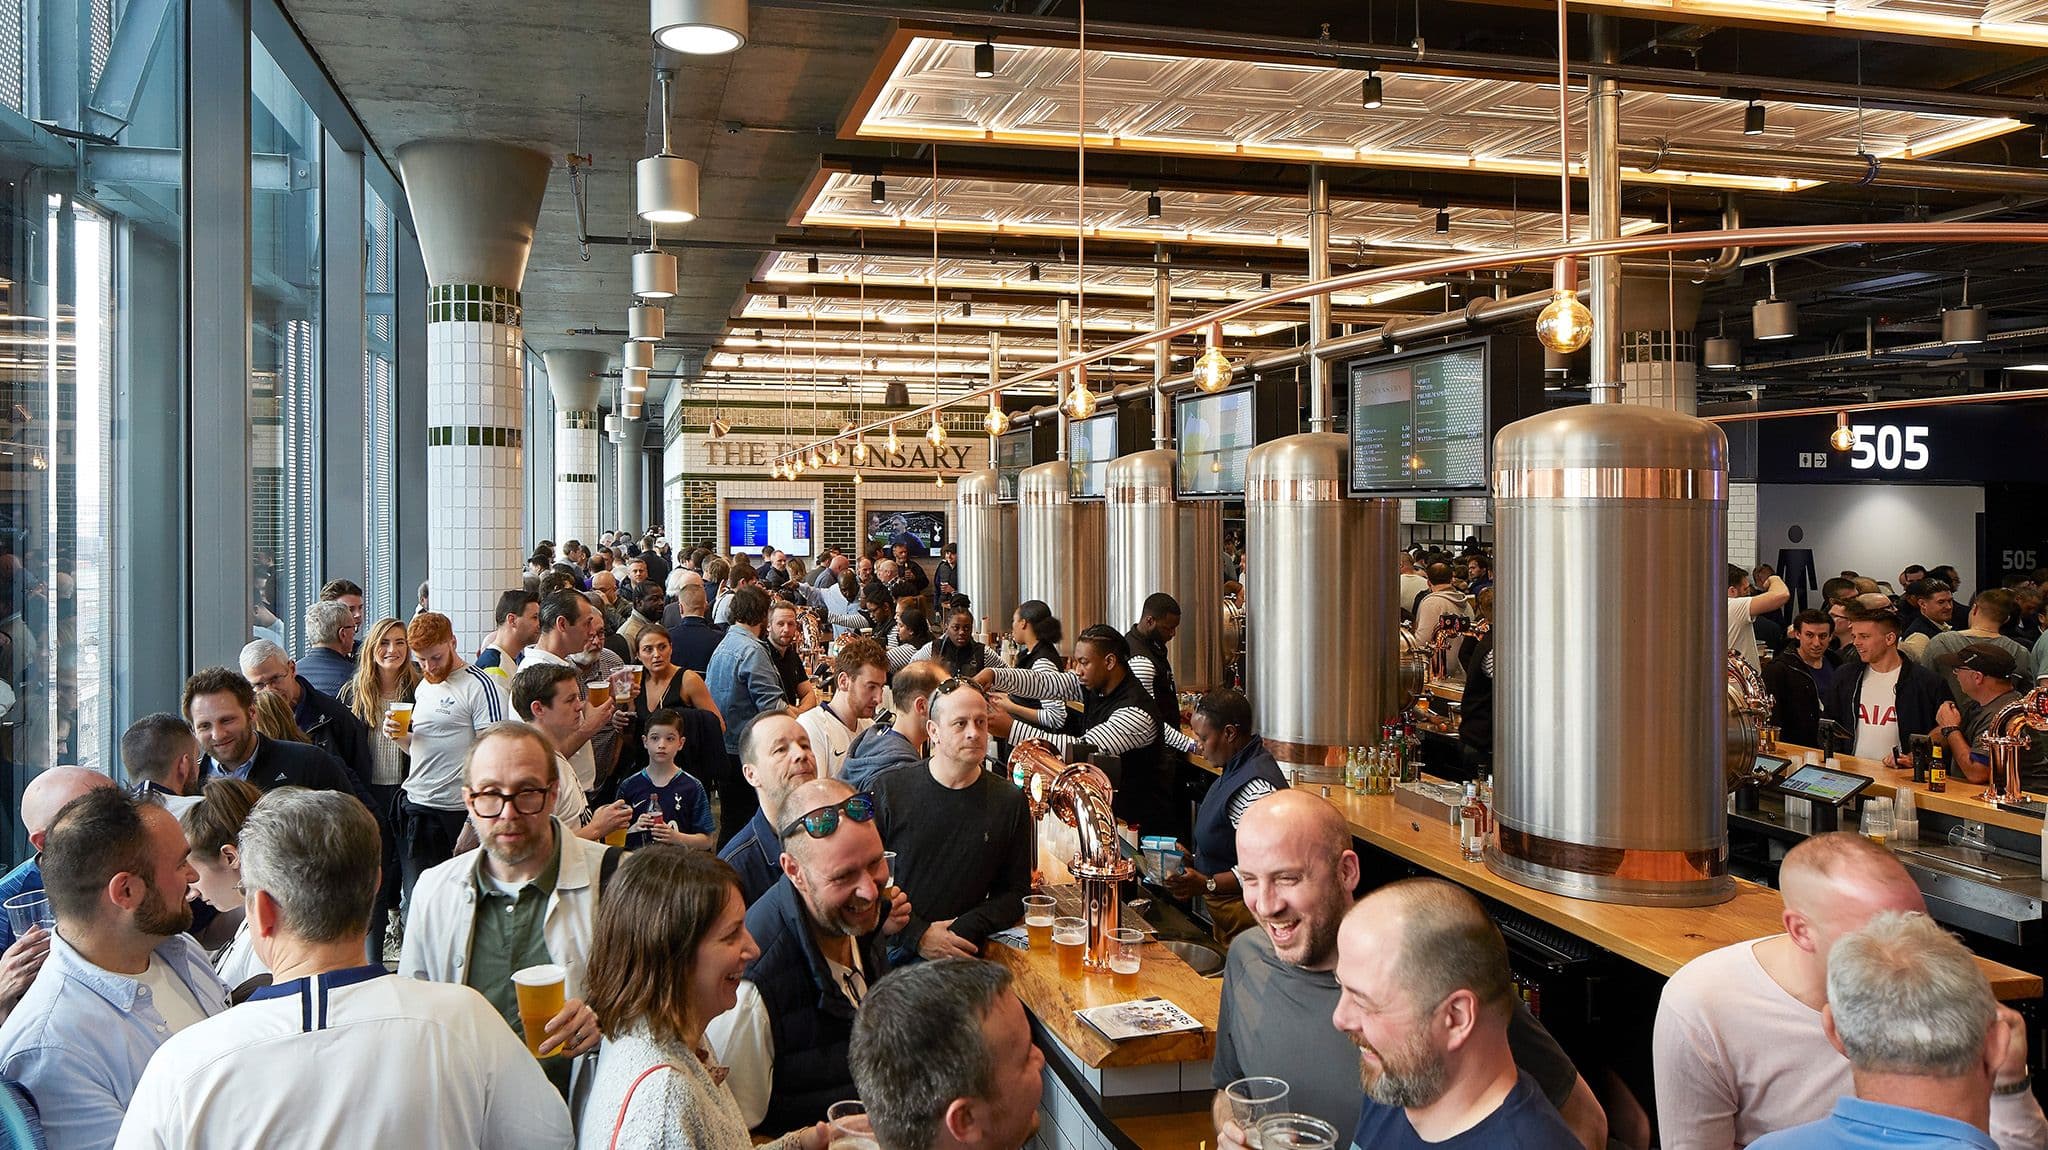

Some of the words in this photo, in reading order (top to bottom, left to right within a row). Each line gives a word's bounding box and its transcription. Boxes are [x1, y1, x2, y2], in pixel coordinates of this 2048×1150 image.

[703, 441, 767, 467] THE
[1851, 424, 1930, 470] 505
[2002, 550, 2037, 570] 505
[1858, 703, 1897, 726] AIA
[1162, 1006, 1193, 1024] SPURS
